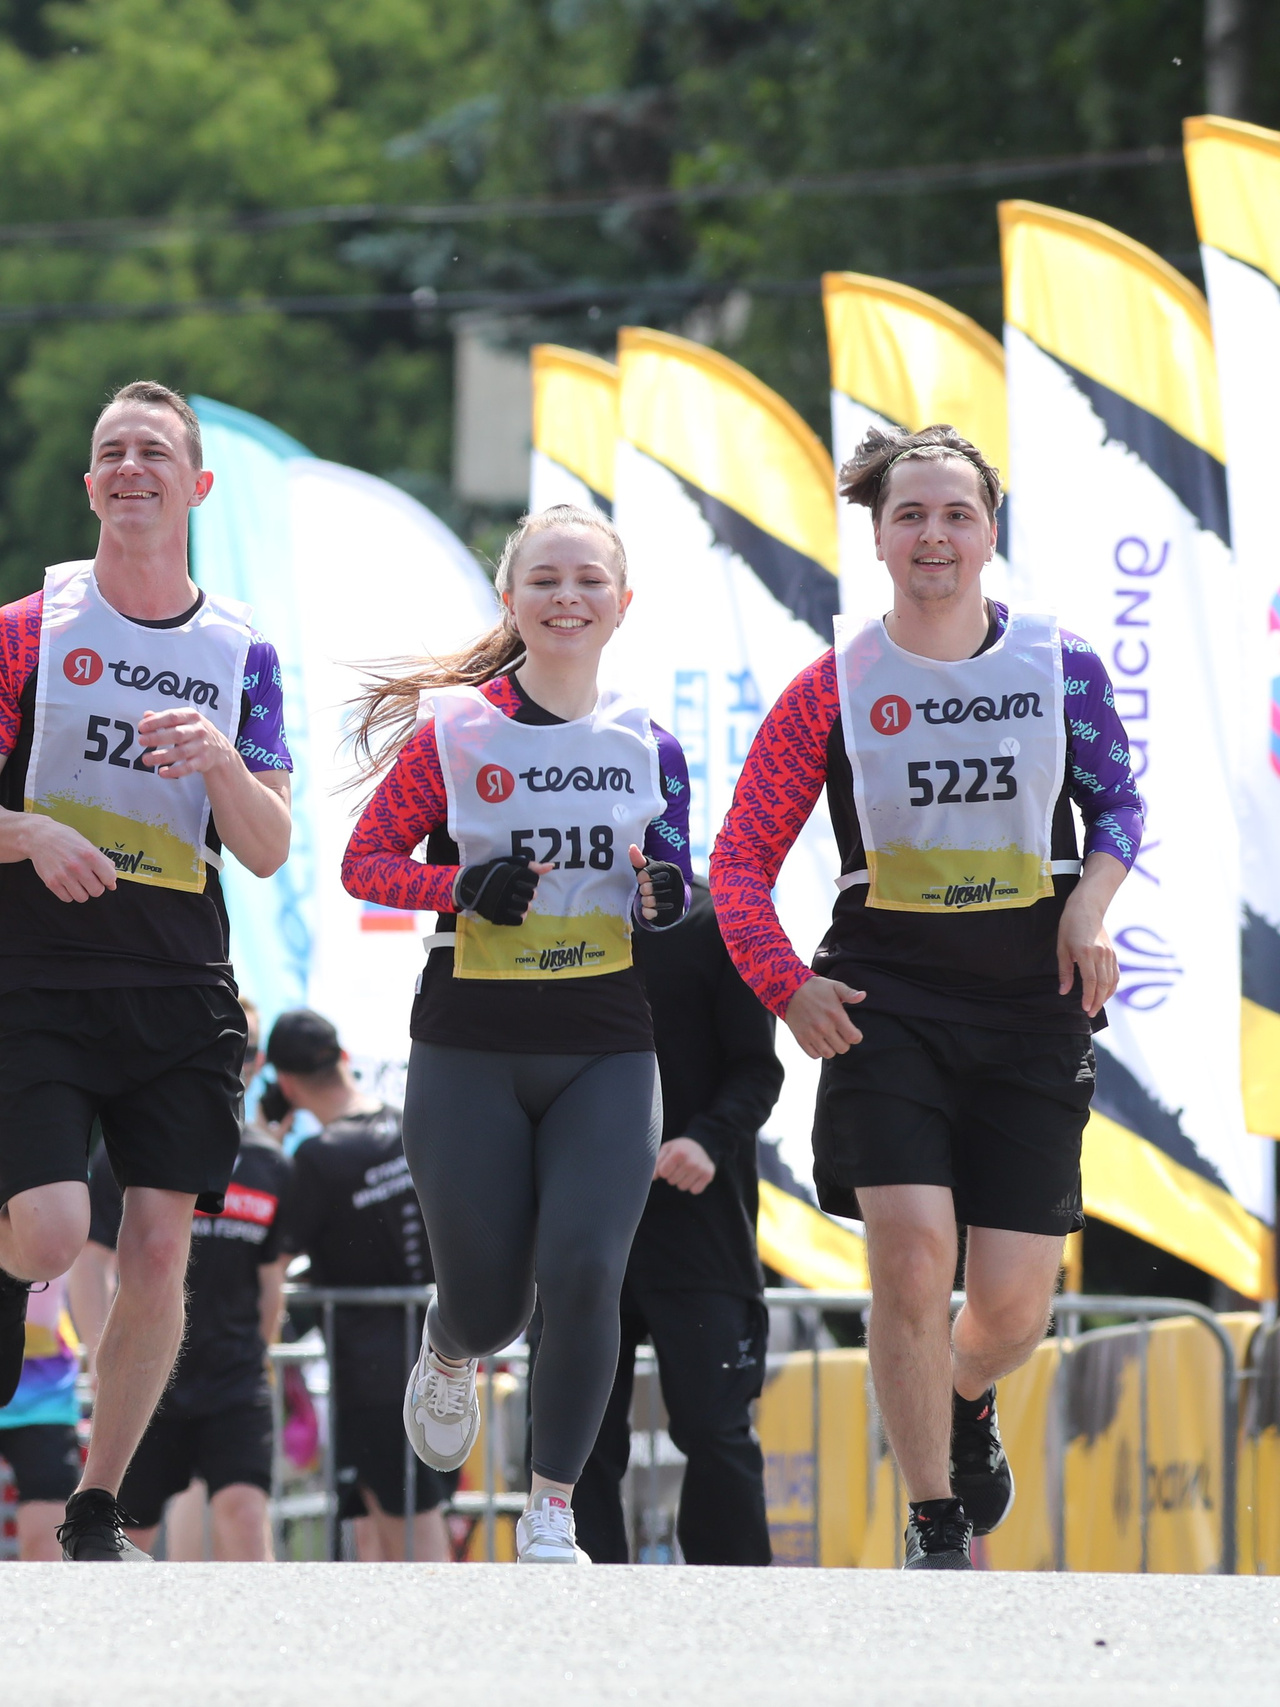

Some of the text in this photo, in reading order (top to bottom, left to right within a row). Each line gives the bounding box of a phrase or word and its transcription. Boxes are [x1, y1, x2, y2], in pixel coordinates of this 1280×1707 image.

[107, 659, 219, 711] team
[821, 654, 835, 696] ndex
[915, 691, 1044, 725] team
[83, 714, 180, 780] 52
[1108, 738, 1131, 768] Yan
[387, 765, 410, 811] ndex
[519, 766, 635, 794] team
[907, 756, 1018, 808] 5223
[1072, 764, 1106, 796] ndex
[740, 778, 784, 838] Yandex
[511, 825, 615, 871] 5218
[739, 889, 772, 910] Yan
[944, 877, 996, 909] URBAN
[539, 941, 586, 972] URBAN
